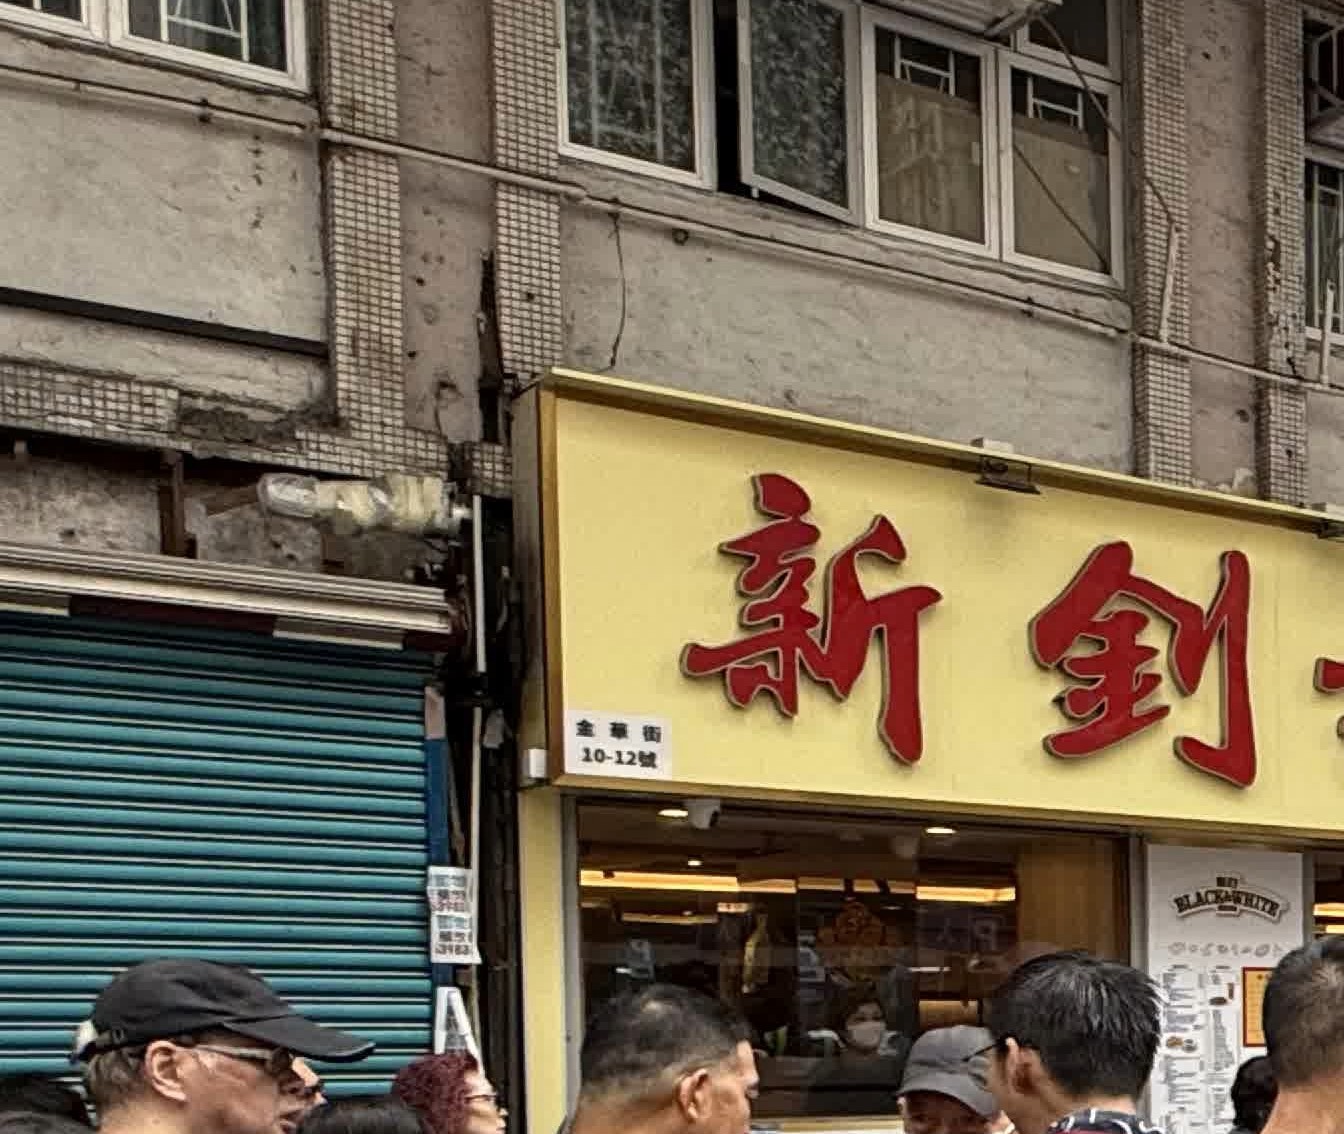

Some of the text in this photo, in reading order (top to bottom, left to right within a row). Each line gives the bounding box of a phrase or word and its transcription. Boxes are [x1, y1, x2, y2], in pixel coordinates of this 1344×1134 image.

[575, 718, 662, 744] 金華街
[581, 746, 658, 769] 10-12號
